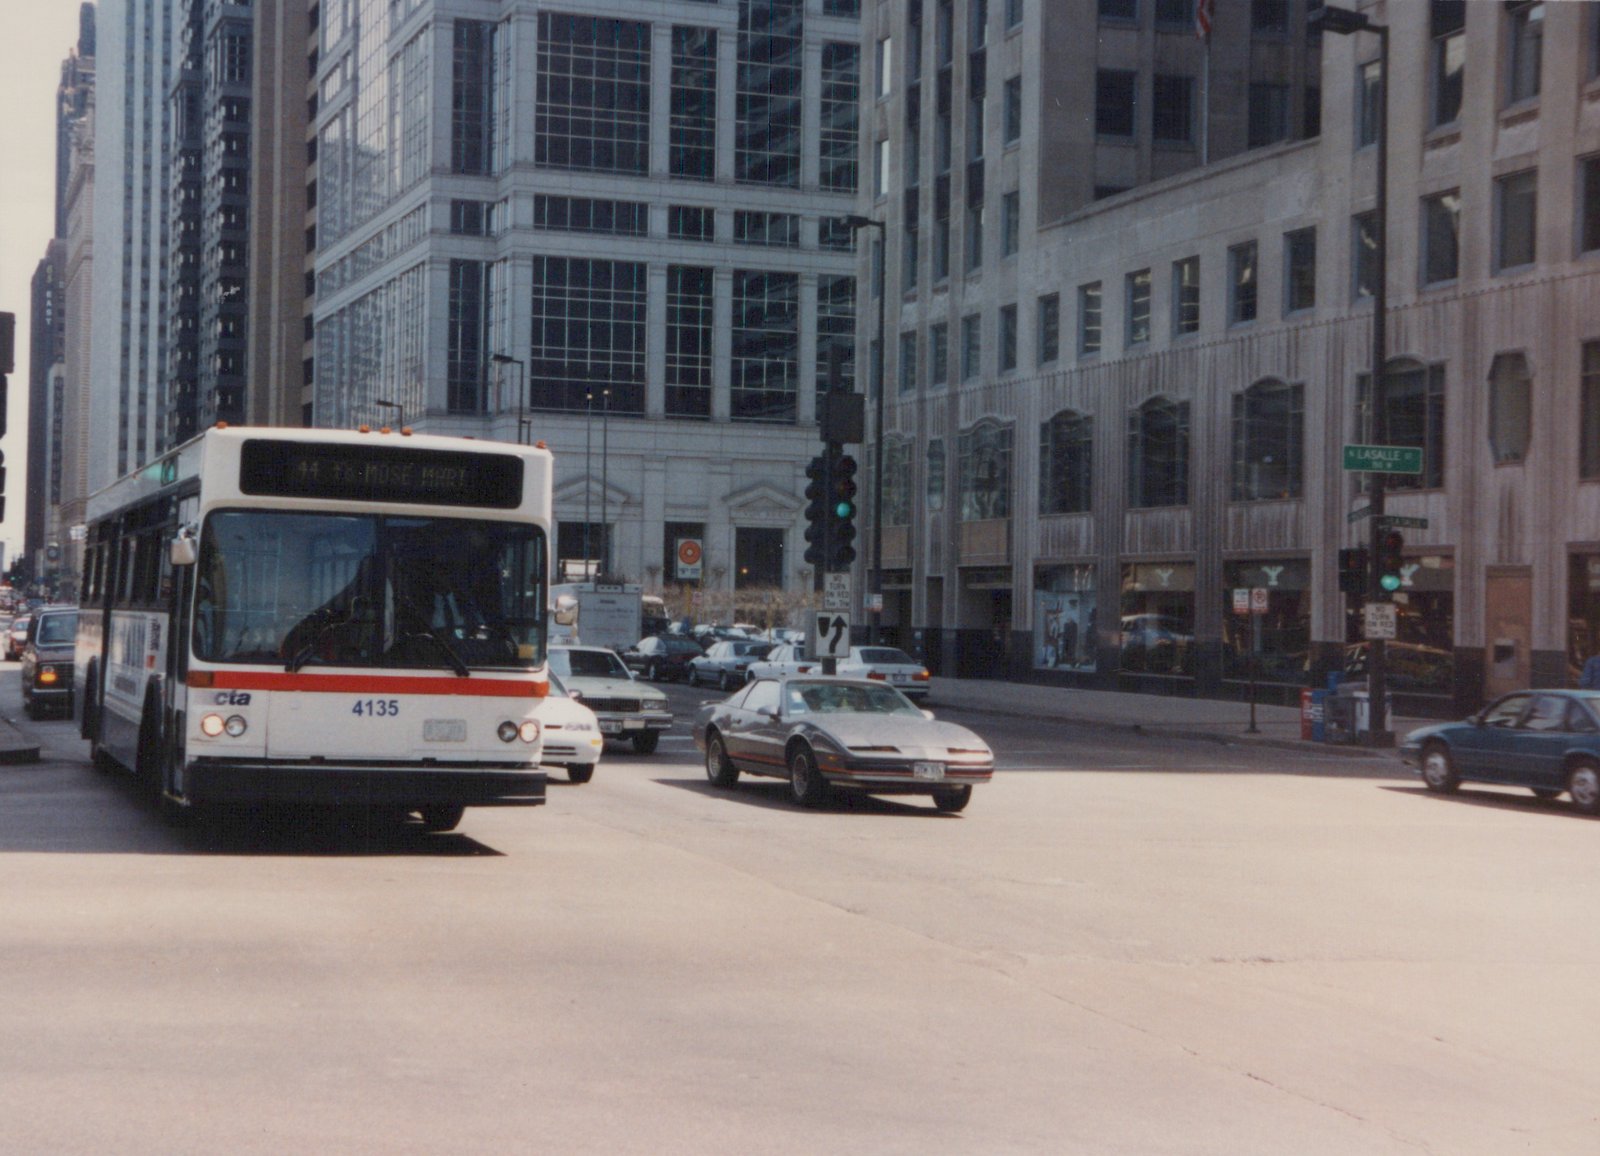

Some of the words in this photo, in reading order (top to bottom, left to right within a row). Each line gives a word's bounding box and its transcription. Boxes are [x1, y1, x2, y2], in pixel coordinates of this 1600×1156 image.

[1357, 448, 1401, 461] LASALLE
[215, 689, 251, 706] cta
[352, 699, 400, 717] 4135
